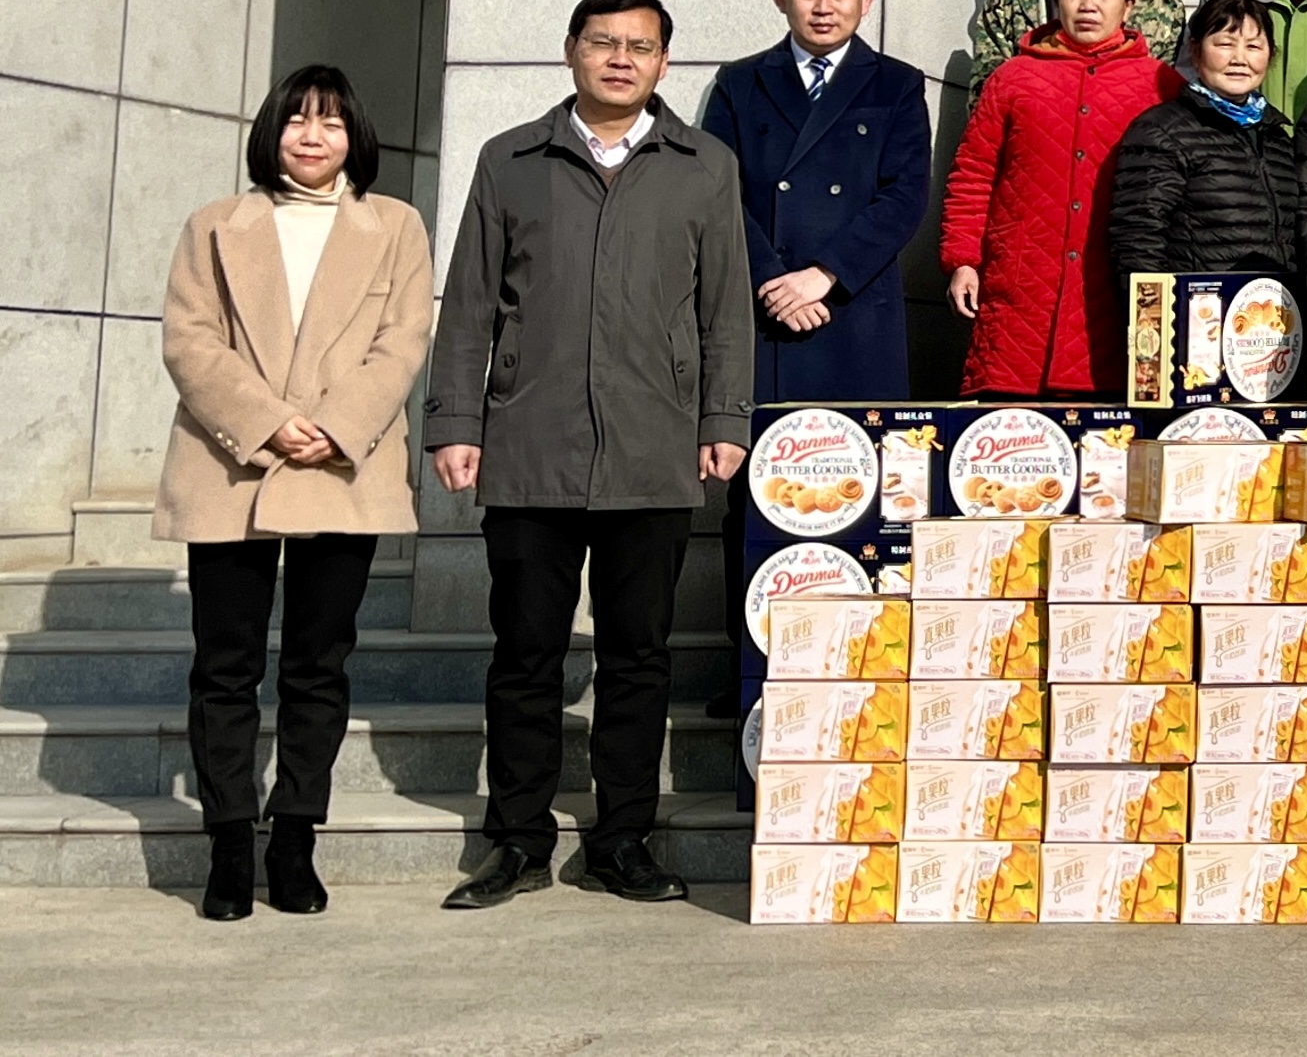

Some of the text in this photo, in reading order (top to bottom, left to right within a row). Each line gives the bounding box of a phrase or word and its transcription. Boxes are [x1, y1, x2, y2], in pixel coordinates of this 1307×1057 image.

[771, 465, 859, 476] BUTTER COOKIES
[970, 465, 1058, 476] BUTTER COOKIES
